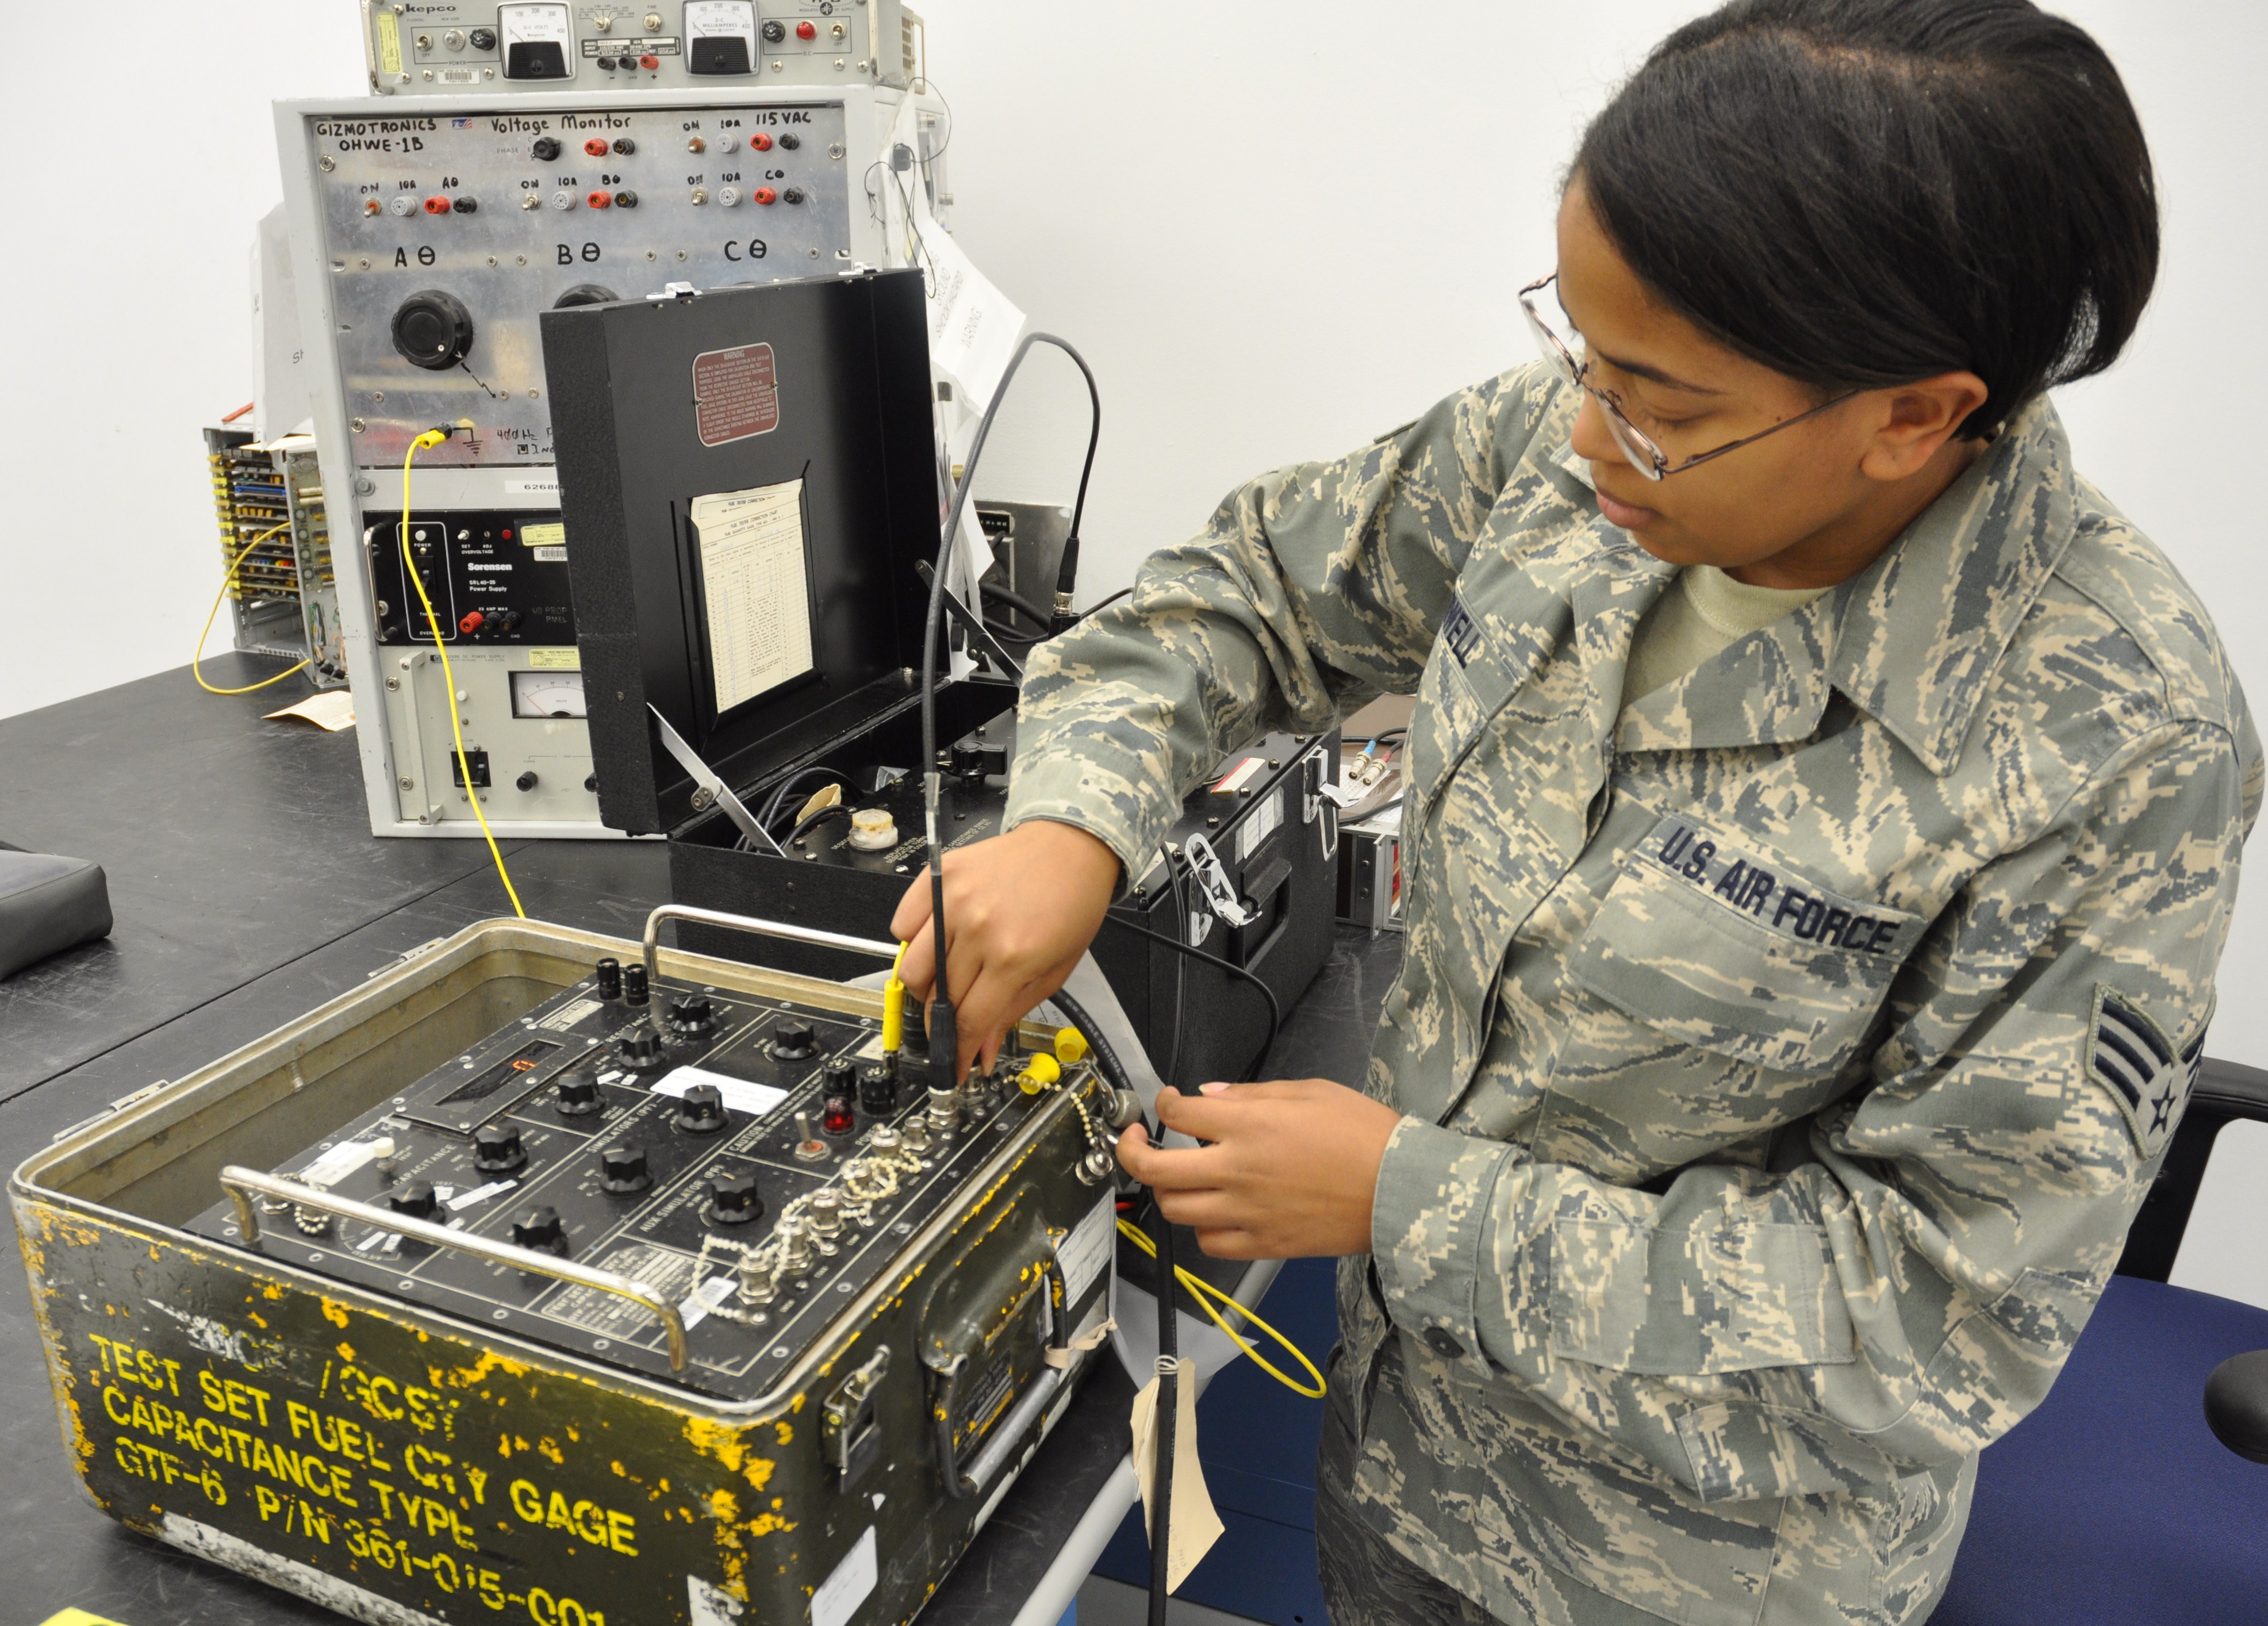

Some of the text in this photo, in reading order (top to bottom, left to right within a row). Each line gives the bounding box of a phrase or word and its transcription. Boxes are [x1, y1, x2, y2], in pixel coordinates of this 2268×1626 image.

[405, 3, 456, 14] kepco
[317, 119, 437, 136] GIZMOTRONICS
[492, 114, 631, 135] Voltage Monitor
[339, 137, 424, 152] OHWE-1B
[723, 350, 745, 360] WARNING
[468, 563, 512, 571] Sorensen
[546, 607, 567, 615] PROP
[1659, 826, 1901, 954] U.S. AIR FORCE
[1080, 1013, 1099, 1038] CABLE
[584, 1102, 659, 1154] SIMULATORS (PF)
[727, 1125, 767, 1152] CAUTION
[390, 1142, 459, 1187] CAPACITANCE
[637, 1163, 727, 1232] AUX SIMULATOR (PF)
[89, 1333, 182, 1397] TEST
[199, 1369, 270, 1427] SET
[286, 1399, 393, 1472] FUEL
[509, 1478, 639, 1556] GAGE
[103, 1386, 479, 1552] CAPACITANCE TYPE
[115, 1437, 228, 1506] GTF-6
[256, 1485, 331, 1545] P/N
